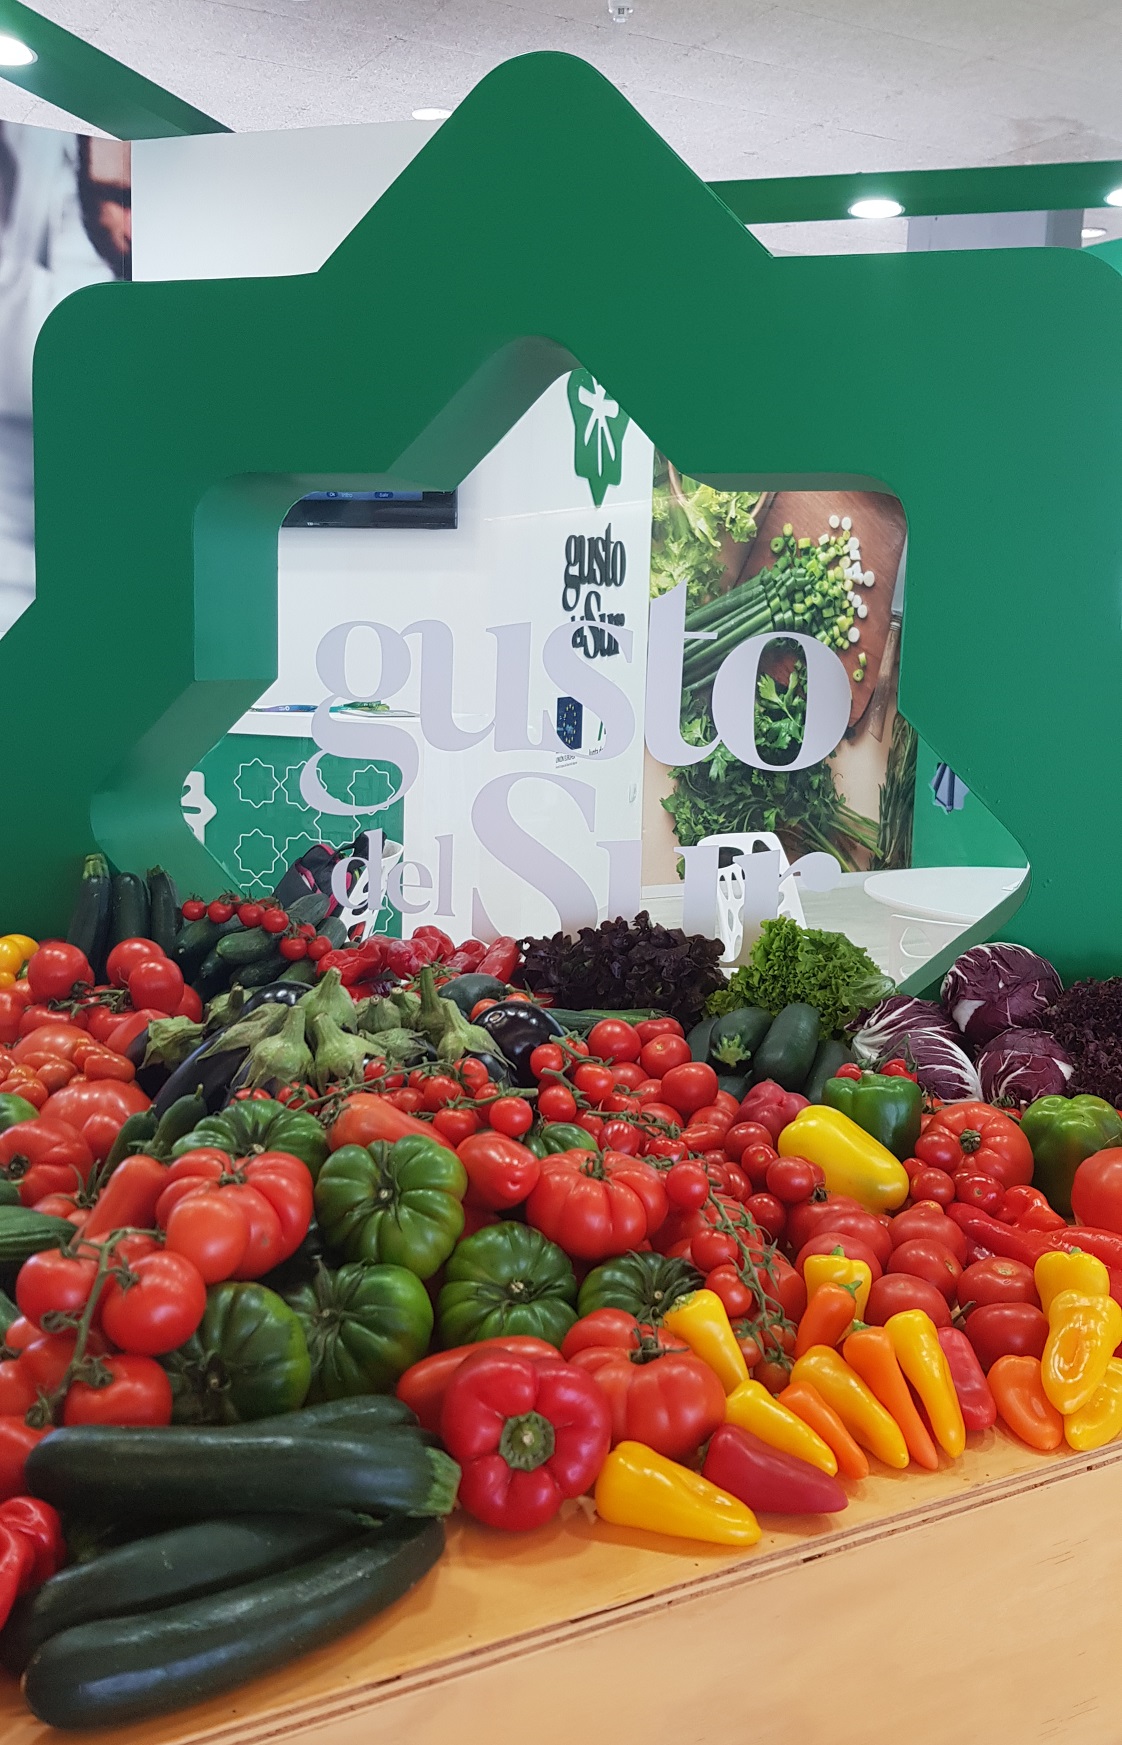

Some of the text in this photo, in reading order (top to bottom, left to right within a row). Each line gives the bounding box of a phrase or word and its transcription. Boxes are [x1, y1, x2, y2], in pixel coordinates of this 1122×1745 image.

[562, 523, 627, 612] gusto
[300, 578, 852, 816] gusto
[331, 771, 842, 967] del Sur
